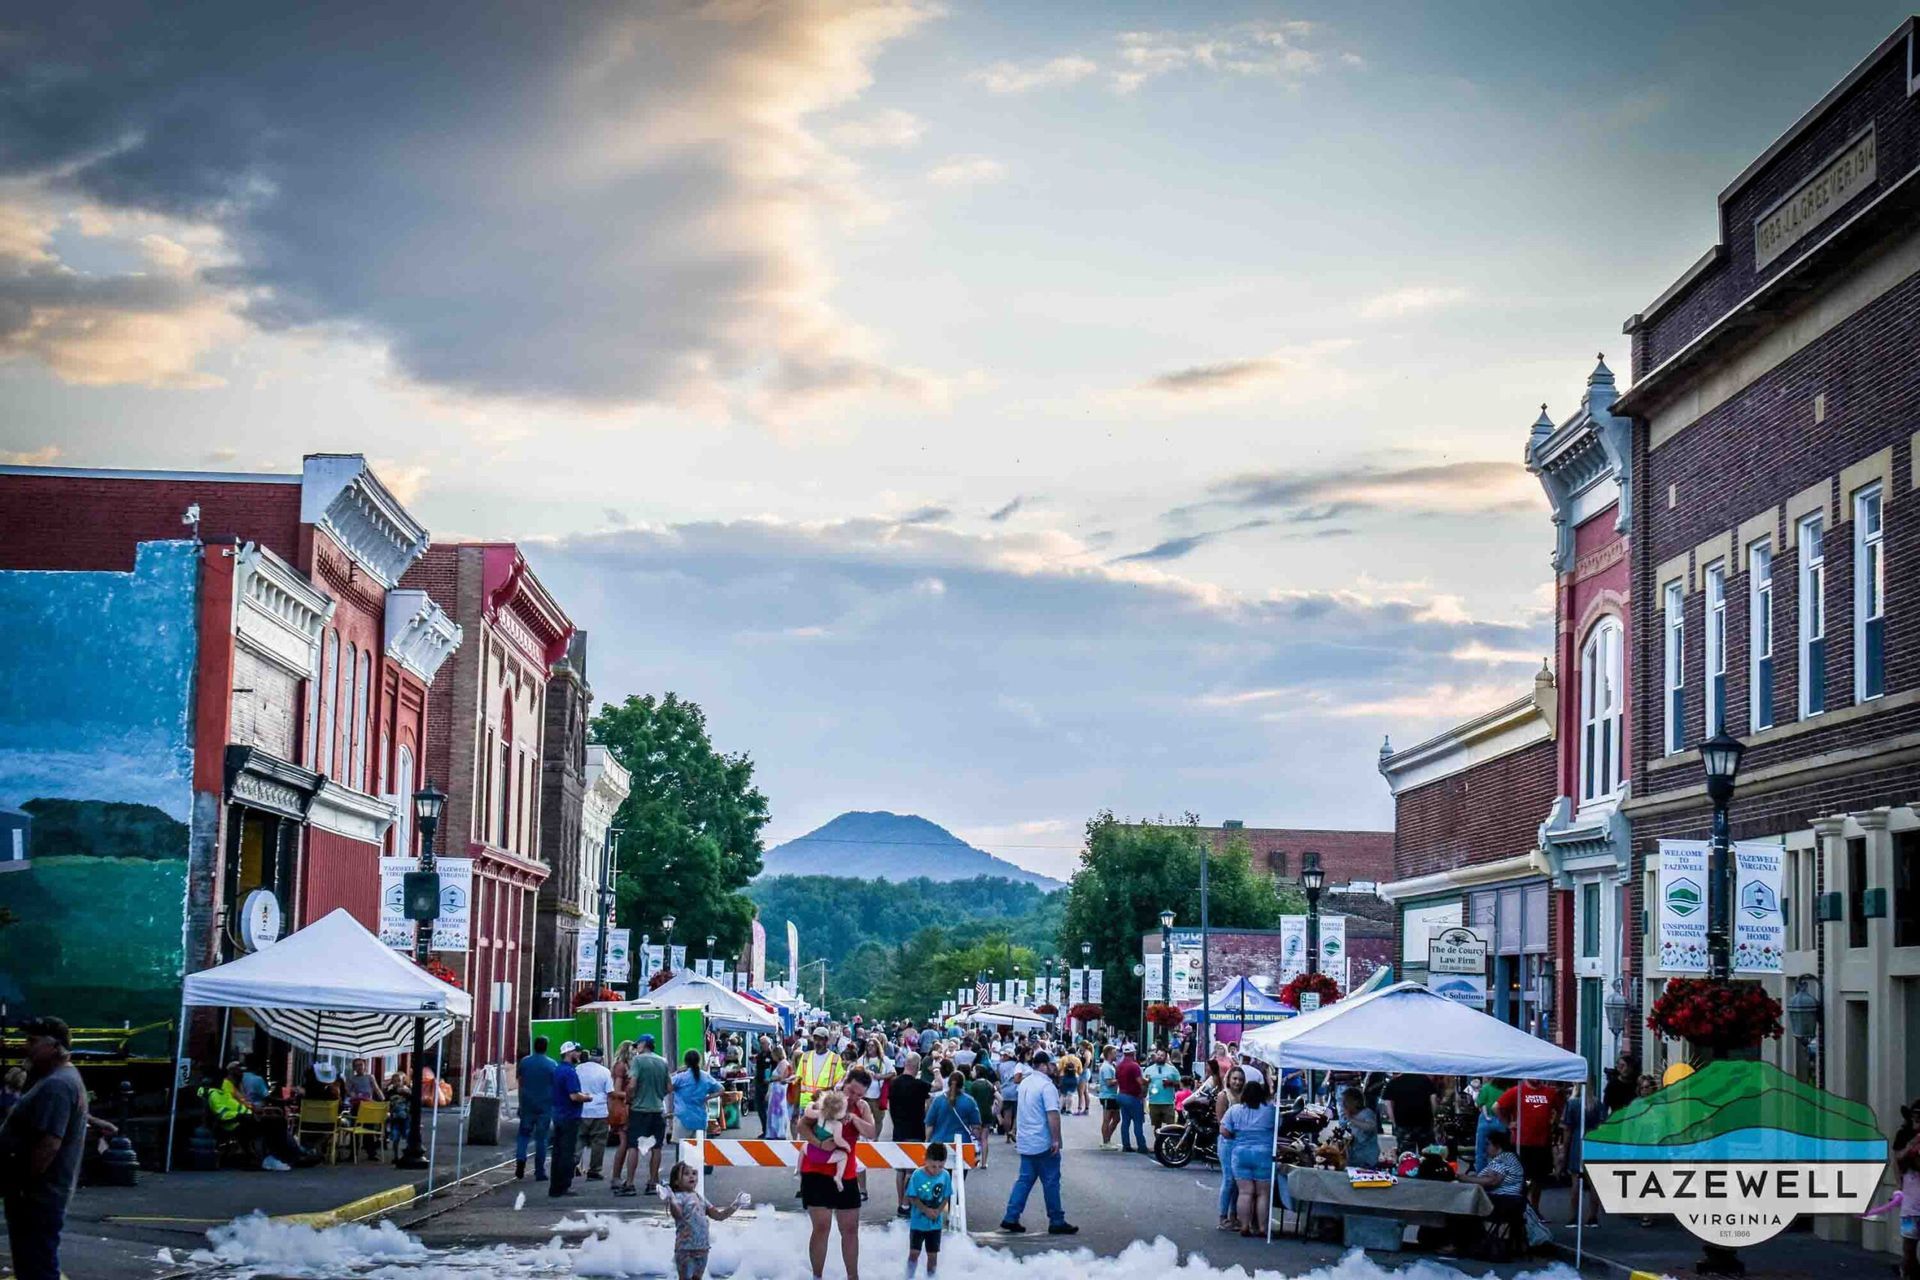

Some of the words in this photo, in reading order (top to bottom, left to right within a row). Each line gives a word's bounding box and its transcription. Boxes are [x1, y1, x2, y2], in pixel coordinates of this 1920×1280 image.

[1664, 849, 1703, 857] WELCOME
[1738, 854, 1780, 864] TAZEWELL
[1740, 862, 1777, 871] VIRGINIA
[1738, 925, 1780, 933] WELCOME
[1458, 947, 1484, 956] Courcy
[1449, 992, 1484, 1000] Solutions
